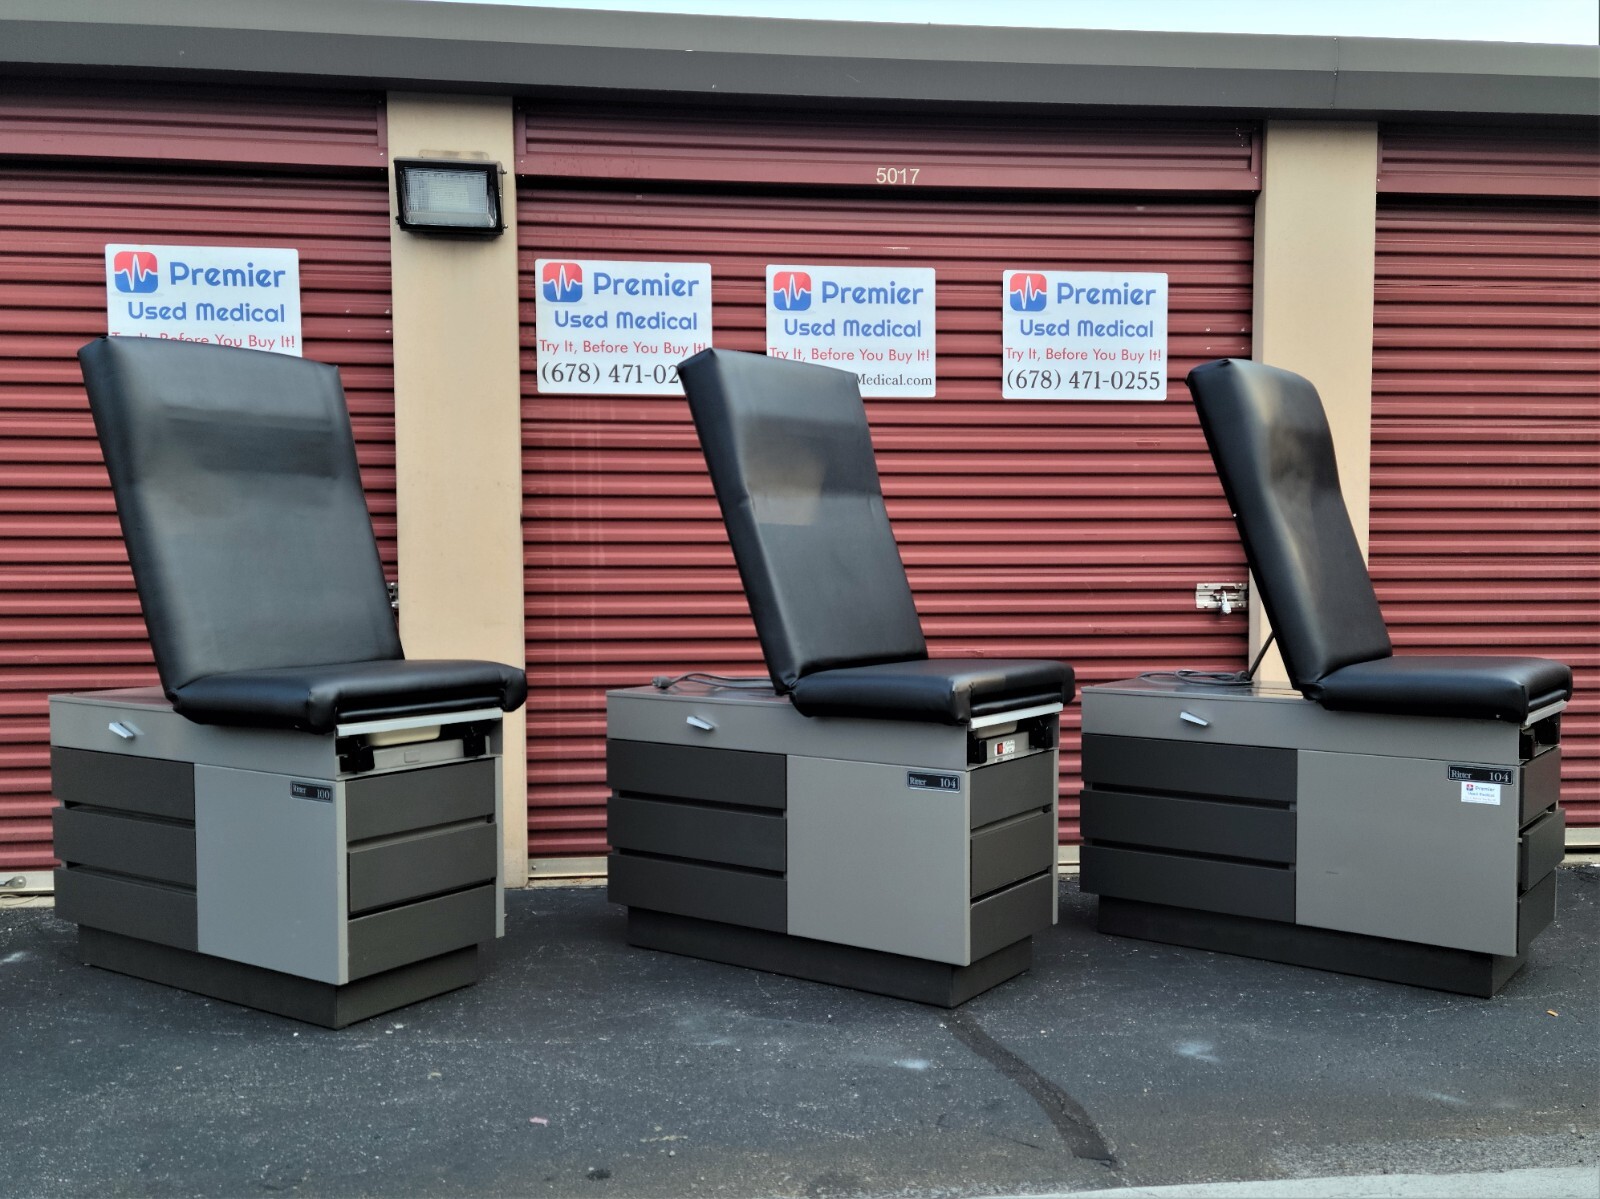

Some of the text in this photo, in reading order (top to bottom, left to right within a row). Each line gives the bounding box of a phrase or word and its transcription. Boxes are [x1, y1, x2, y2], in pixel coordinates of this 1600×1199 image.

[876, 167, 920, 184] 5017
[170, 262, 285, 288] Premier
[594, 272, 699, 296] Premier
[822, 281, 923, 304] Premier
[1057, 282, 1156, 305] Premier
[128, 302, 284, 322] Used Medical
[554, 310, 697, 330] Used Medical
[784, 318, 921, 337] Used Medical
[1020, 319, 1153, 337] Used Medical
[215, 334, 242, 348] You
[248, 335, 275, 350] Buy
[281, 336, 294, 348] It!
[539, 340, 559, 355] Try
[565, 340, 577, 354] It,
[584, 340, 628, 353] Before
[633, 341, 658, 354] You
[664, 342, 688, 357] Buy
[769, 347, 929, 364] Try It, Before You Buy It!
[1006, 348, 1161, 364] Try It, Before You Buy It!
[542, 362, 600, 385] (678)
[1007, 369, 1160, 391] (678) 471-0255
[940, 778, 956, 789] 104
[1490, 772, 1509, 782] 104
[317, 789, 329, 799] 100
